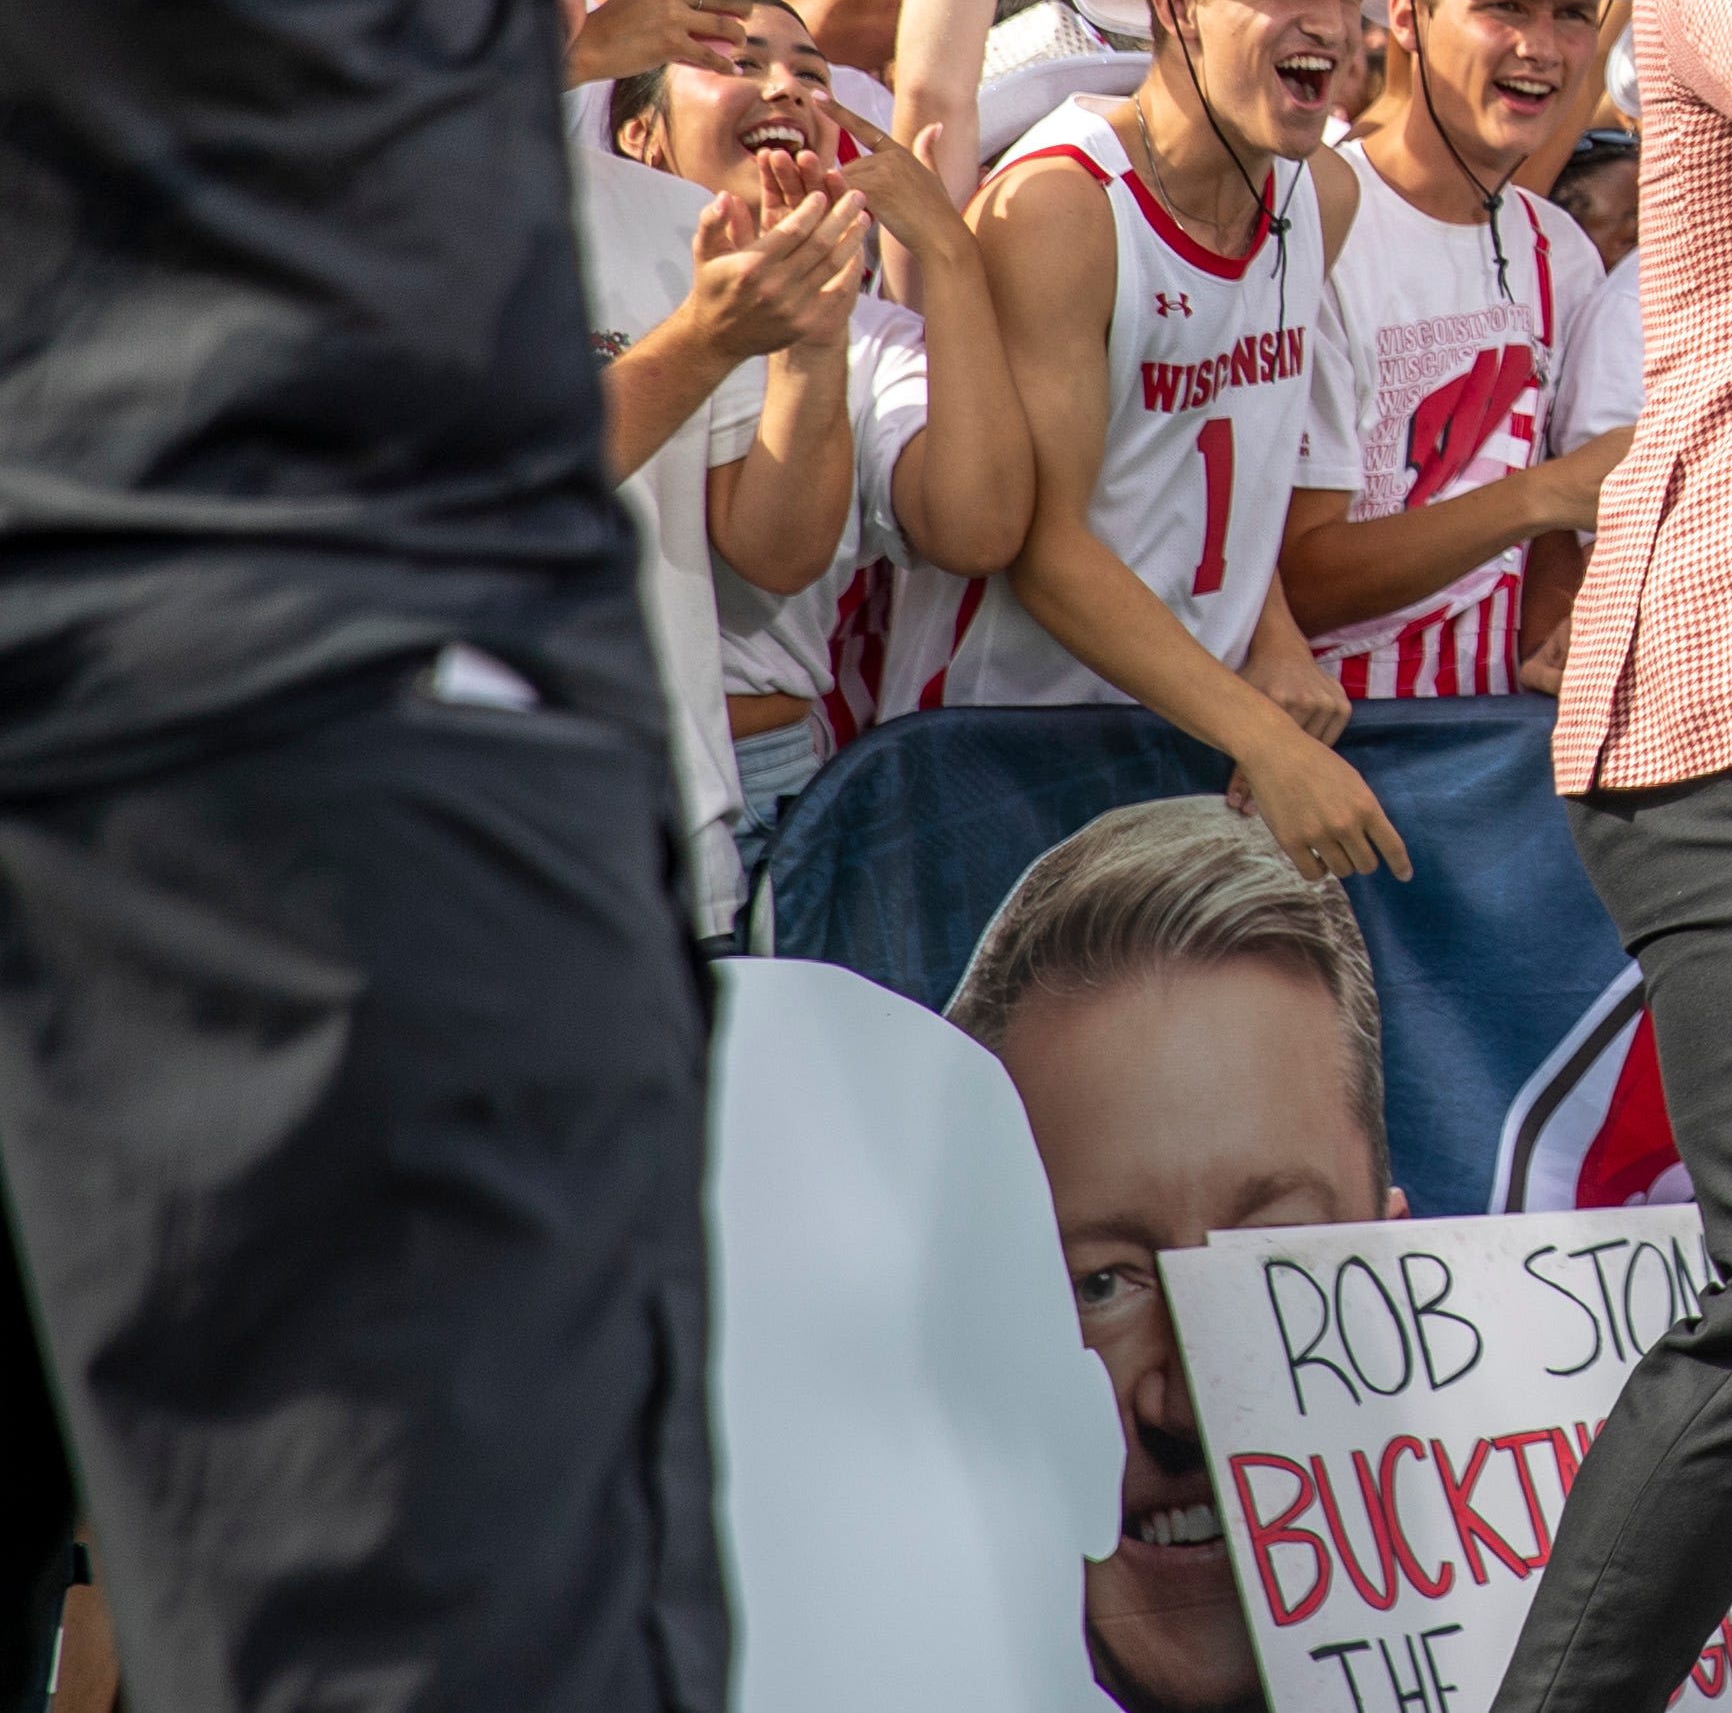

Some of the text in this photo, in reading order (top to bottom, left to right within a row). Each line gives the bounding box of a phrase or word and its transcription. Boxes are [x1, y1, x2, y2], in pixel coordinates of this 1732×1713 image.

[1191, 416, 1235, 597] 1
[1263, 1231, 1722, 1417] ROB STON
[1226, 1417, 1607, 1628] BUCKIN
[1308, 1621, 1465, 1712] THE
